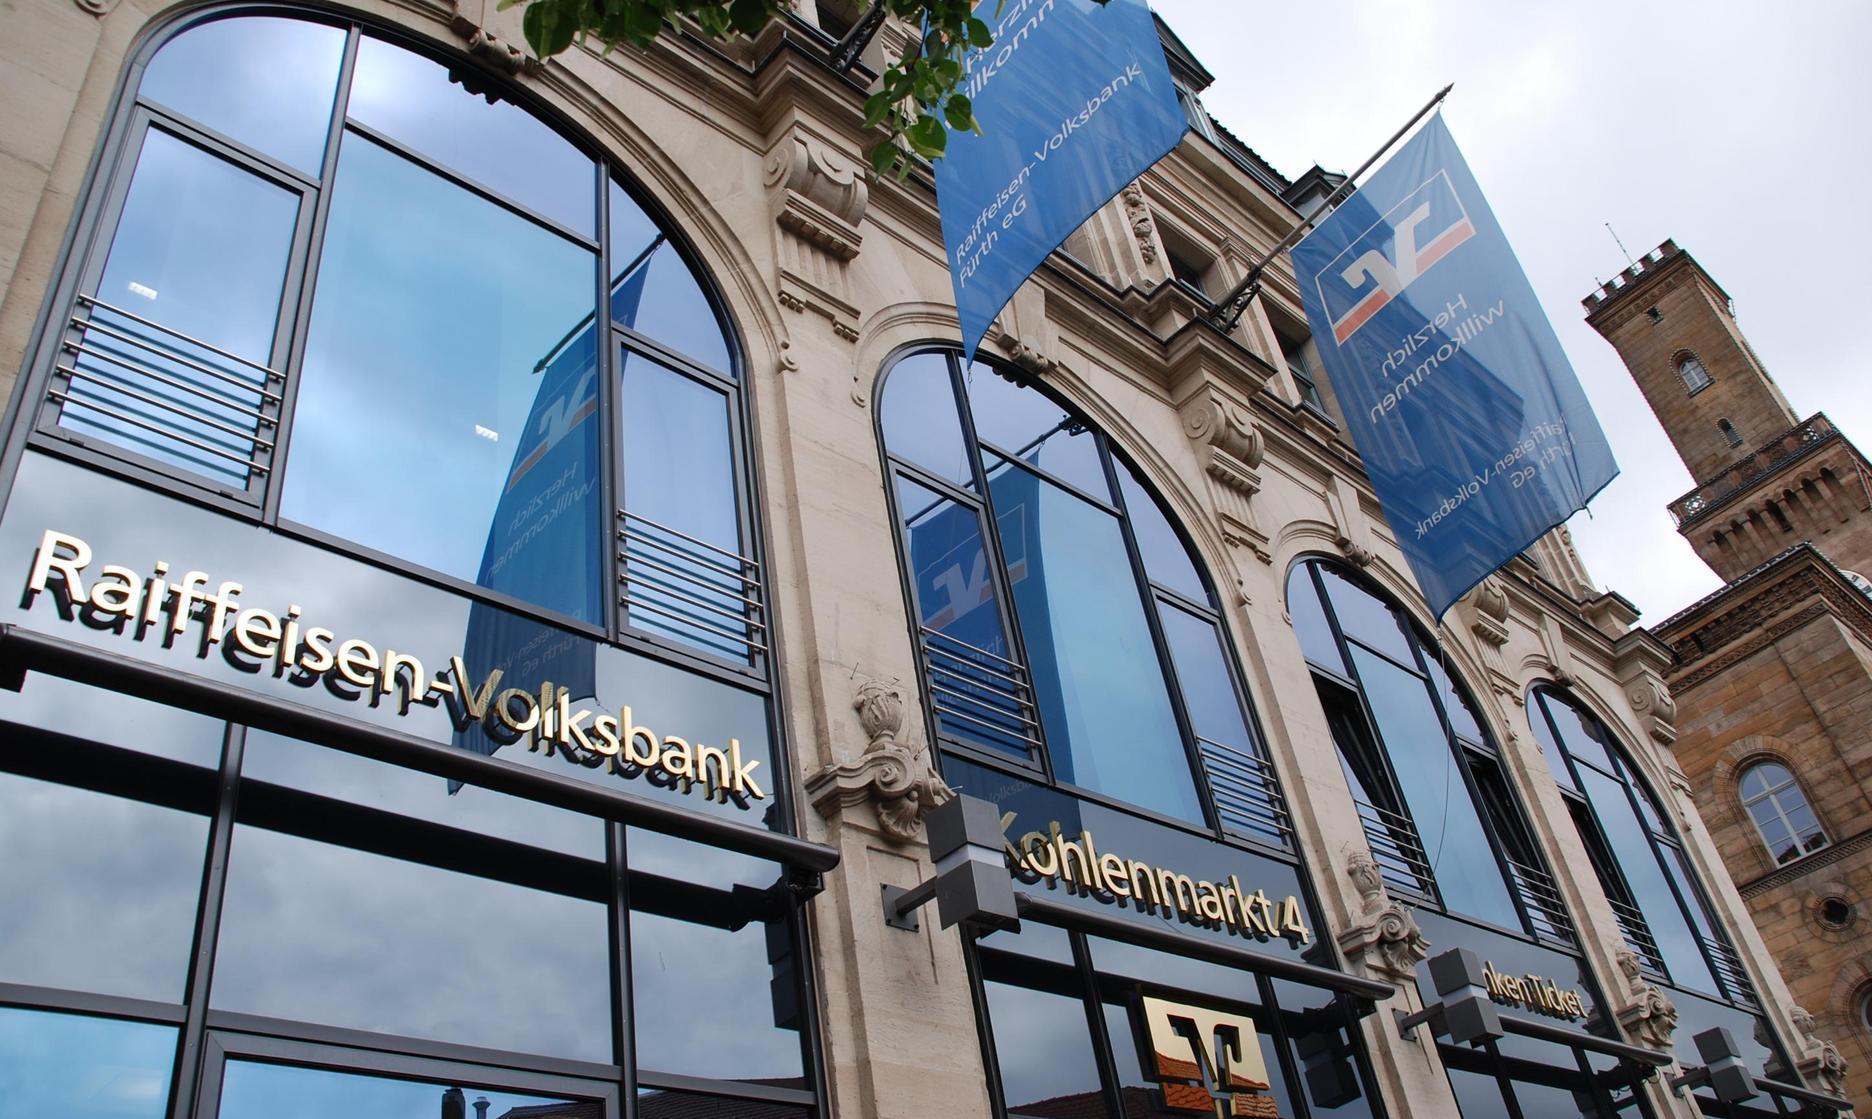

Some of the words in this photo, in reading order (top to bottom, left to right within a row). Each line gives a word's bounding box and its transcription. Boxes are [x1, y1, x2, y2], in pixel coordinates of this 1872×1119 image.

[955, 63, 1141, 265] Raiffeisen-Volksbank
[960, 230, 999, 289] Fürth
[1002, 195, 1028, 230] eG
[29, 529, 764, 800] Raiffeisen-Volksbank
[1283, 895, 1309, 945] 4
